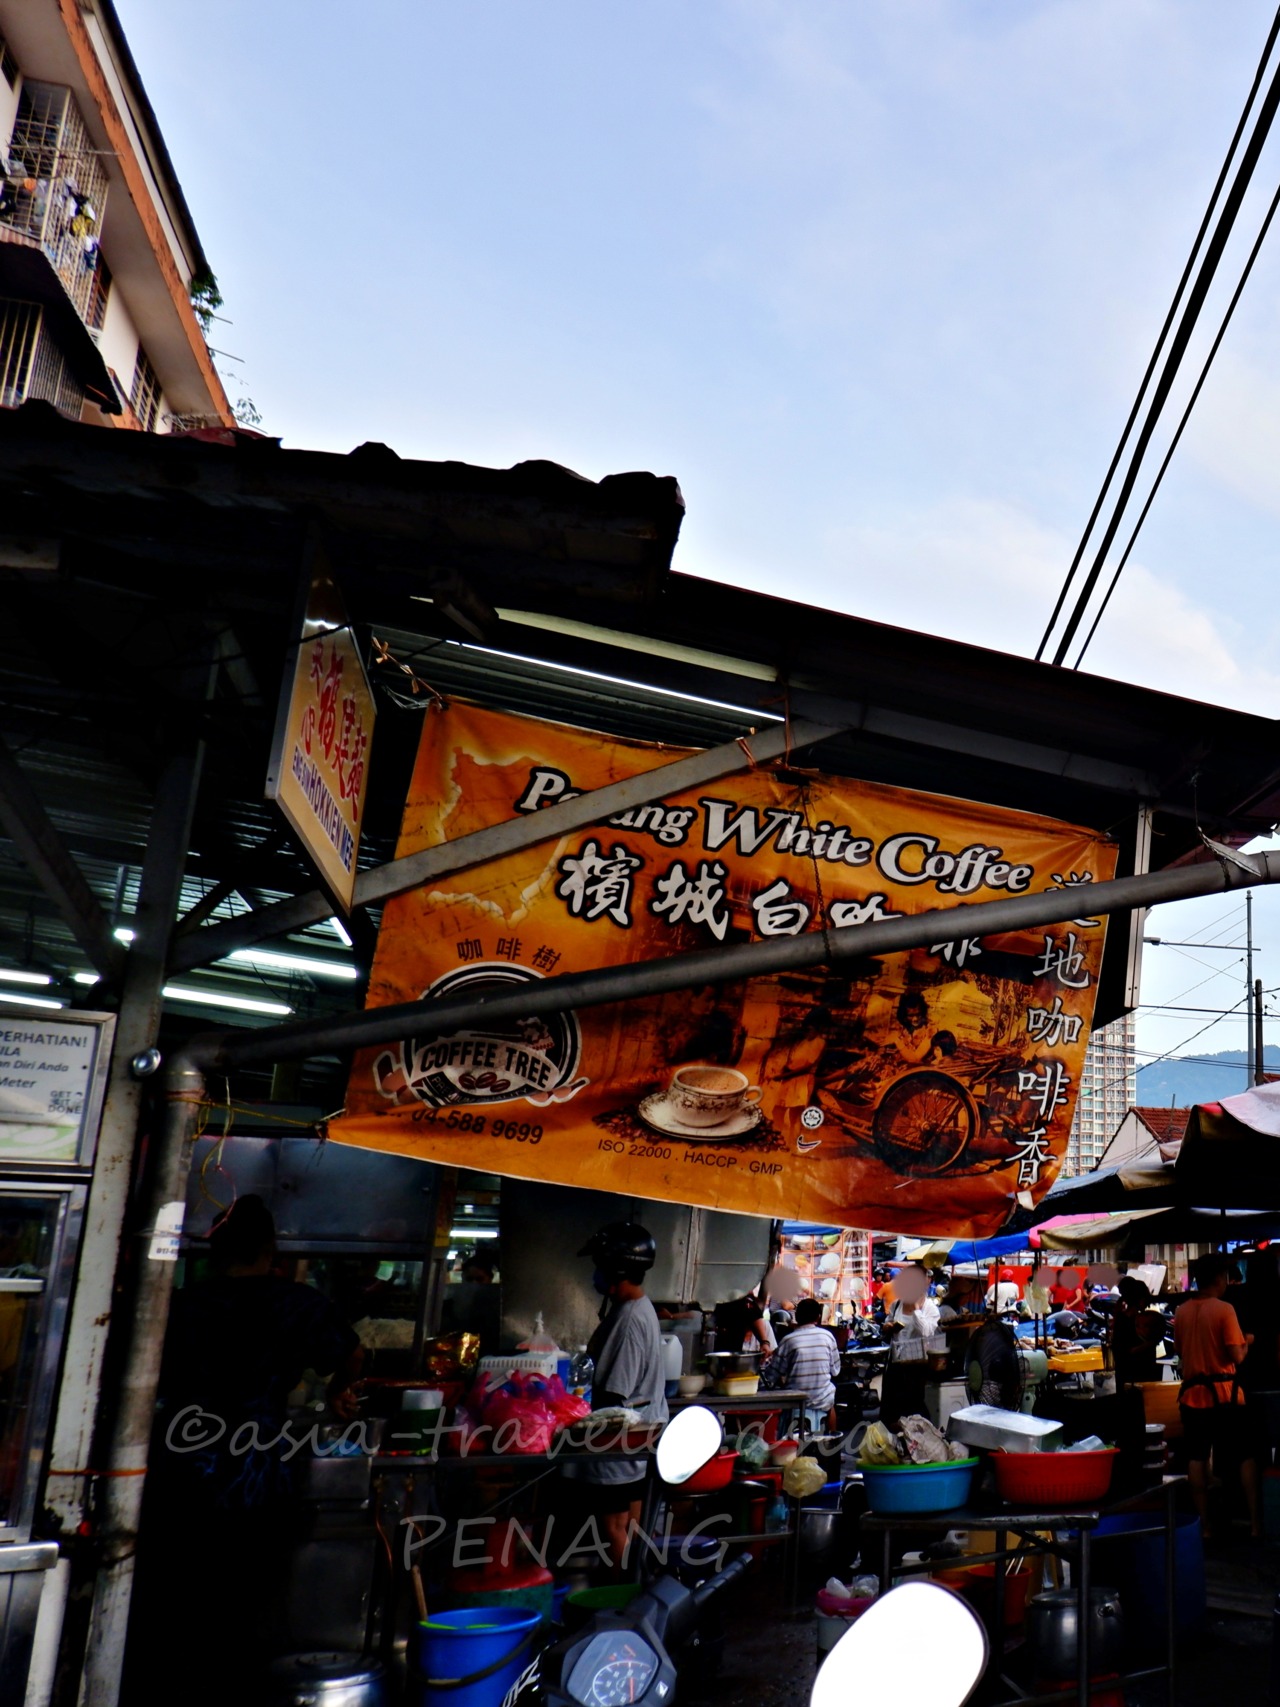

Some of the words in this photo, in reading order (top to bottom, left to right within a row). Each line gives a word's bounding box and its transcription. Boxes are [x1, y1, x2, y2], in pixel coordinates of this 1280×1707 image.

[308, 763, 343, 850] HOKKIEN
[340, 825, 354, 873] MEE
[517, 769, 696, 845] Pang
[700, 800, 871, 863] White
[879, 835, 1034, 893] Coffee
[456, 937, 562, 973] 咖啡樹
[420, 1040, 498, 1073] COFFEE
[505, 1047, 551, 1088] TREE
[411, 1108, 486, 1134] 04-588
[491, 1119, 544, 1145] 9699
[597, 1139, 625, 1154] ISO
[629, 1144, 671, 1160] 22000
[683, 1151, 738, 1169] HACCP
[749, 1160, 783, 1176] GMP
